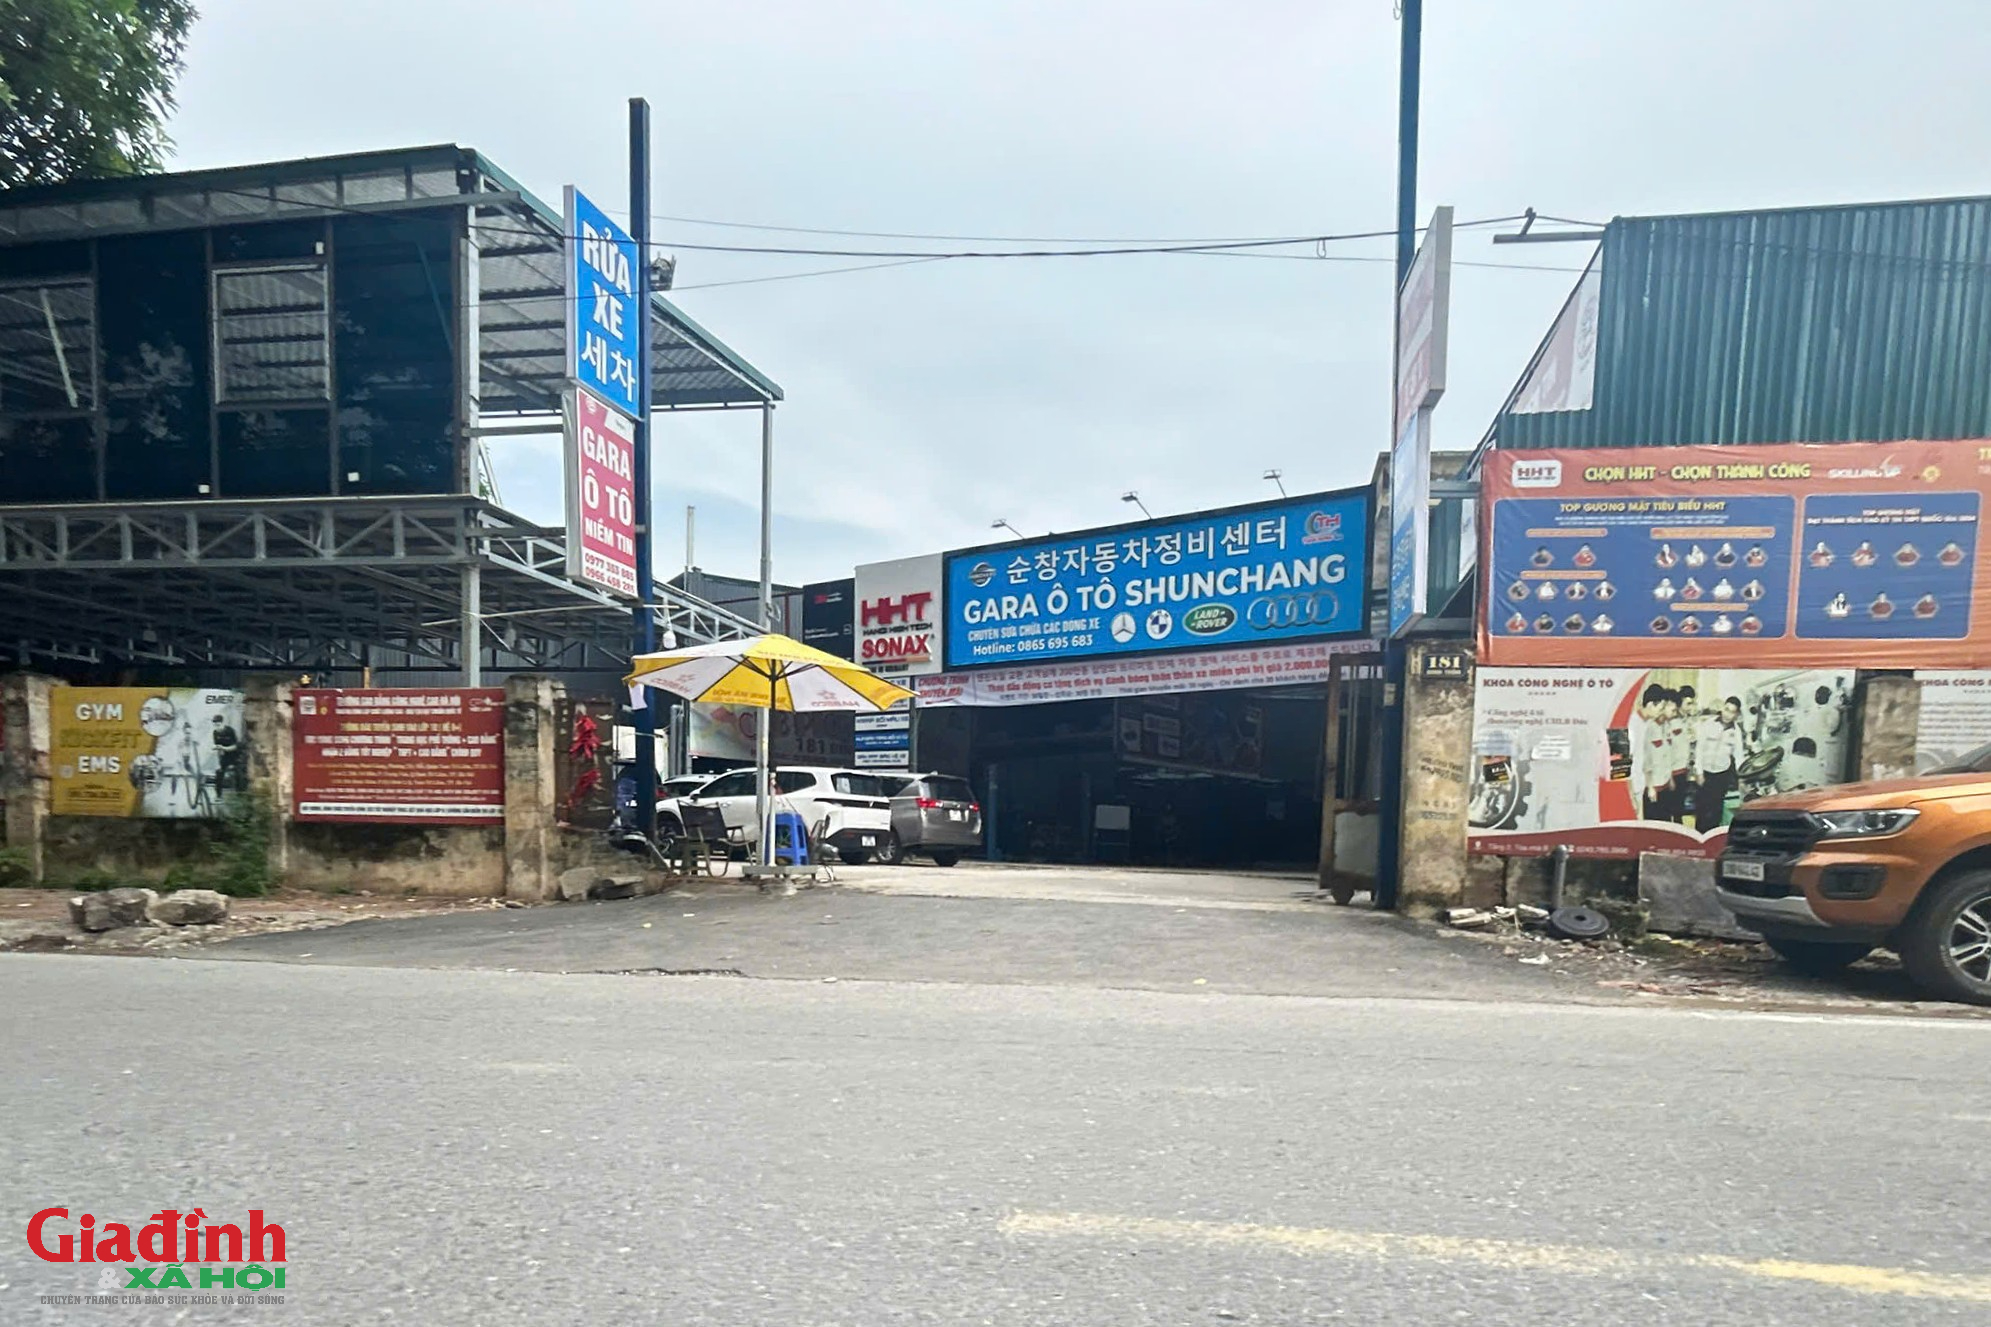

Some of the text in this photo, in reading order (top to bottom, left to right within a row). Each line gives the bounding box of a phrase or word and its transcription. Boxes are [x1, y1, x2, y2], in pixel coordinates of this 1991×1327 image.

[583, 220, 631, 298] RỬA
[592, 281, 624, 341] XE
[581, 330, 636, 403] 세차
[582, 425, 631, 481] GARA
[1516, 467, 1556, 477] HHT
[1584, 467, 1625, 483] CHỌN
[1628, 466, 1657, 480] HHT
[1671, 466, 1712, 483] CHỌN
[584, 467, 632, 526] Ô TÔ
[616, 532, 633, 556] TIN
[1006, 515, 1287, 585] 순창자동차정비센터
[964, 553, 1346, 624] GARA Ô TÔ SHUNCHANG
[862, 591, 933, 627] HHT
[910, 622, 933, 631] TECH
[1089, 617, 1101, 630] XE
[861, 633, 931, 658] SONAX
[973, 634, 1093, 656] Hotline: 0865 695 683
[1428, 656, 1461, 669] 181
[1483, 679, 1514, 687] KHOA
[1517, 677, 1549, 688] CÔNG
[75, 703, 124, 721] GYM
[77, 755, 121, 774] EMS
